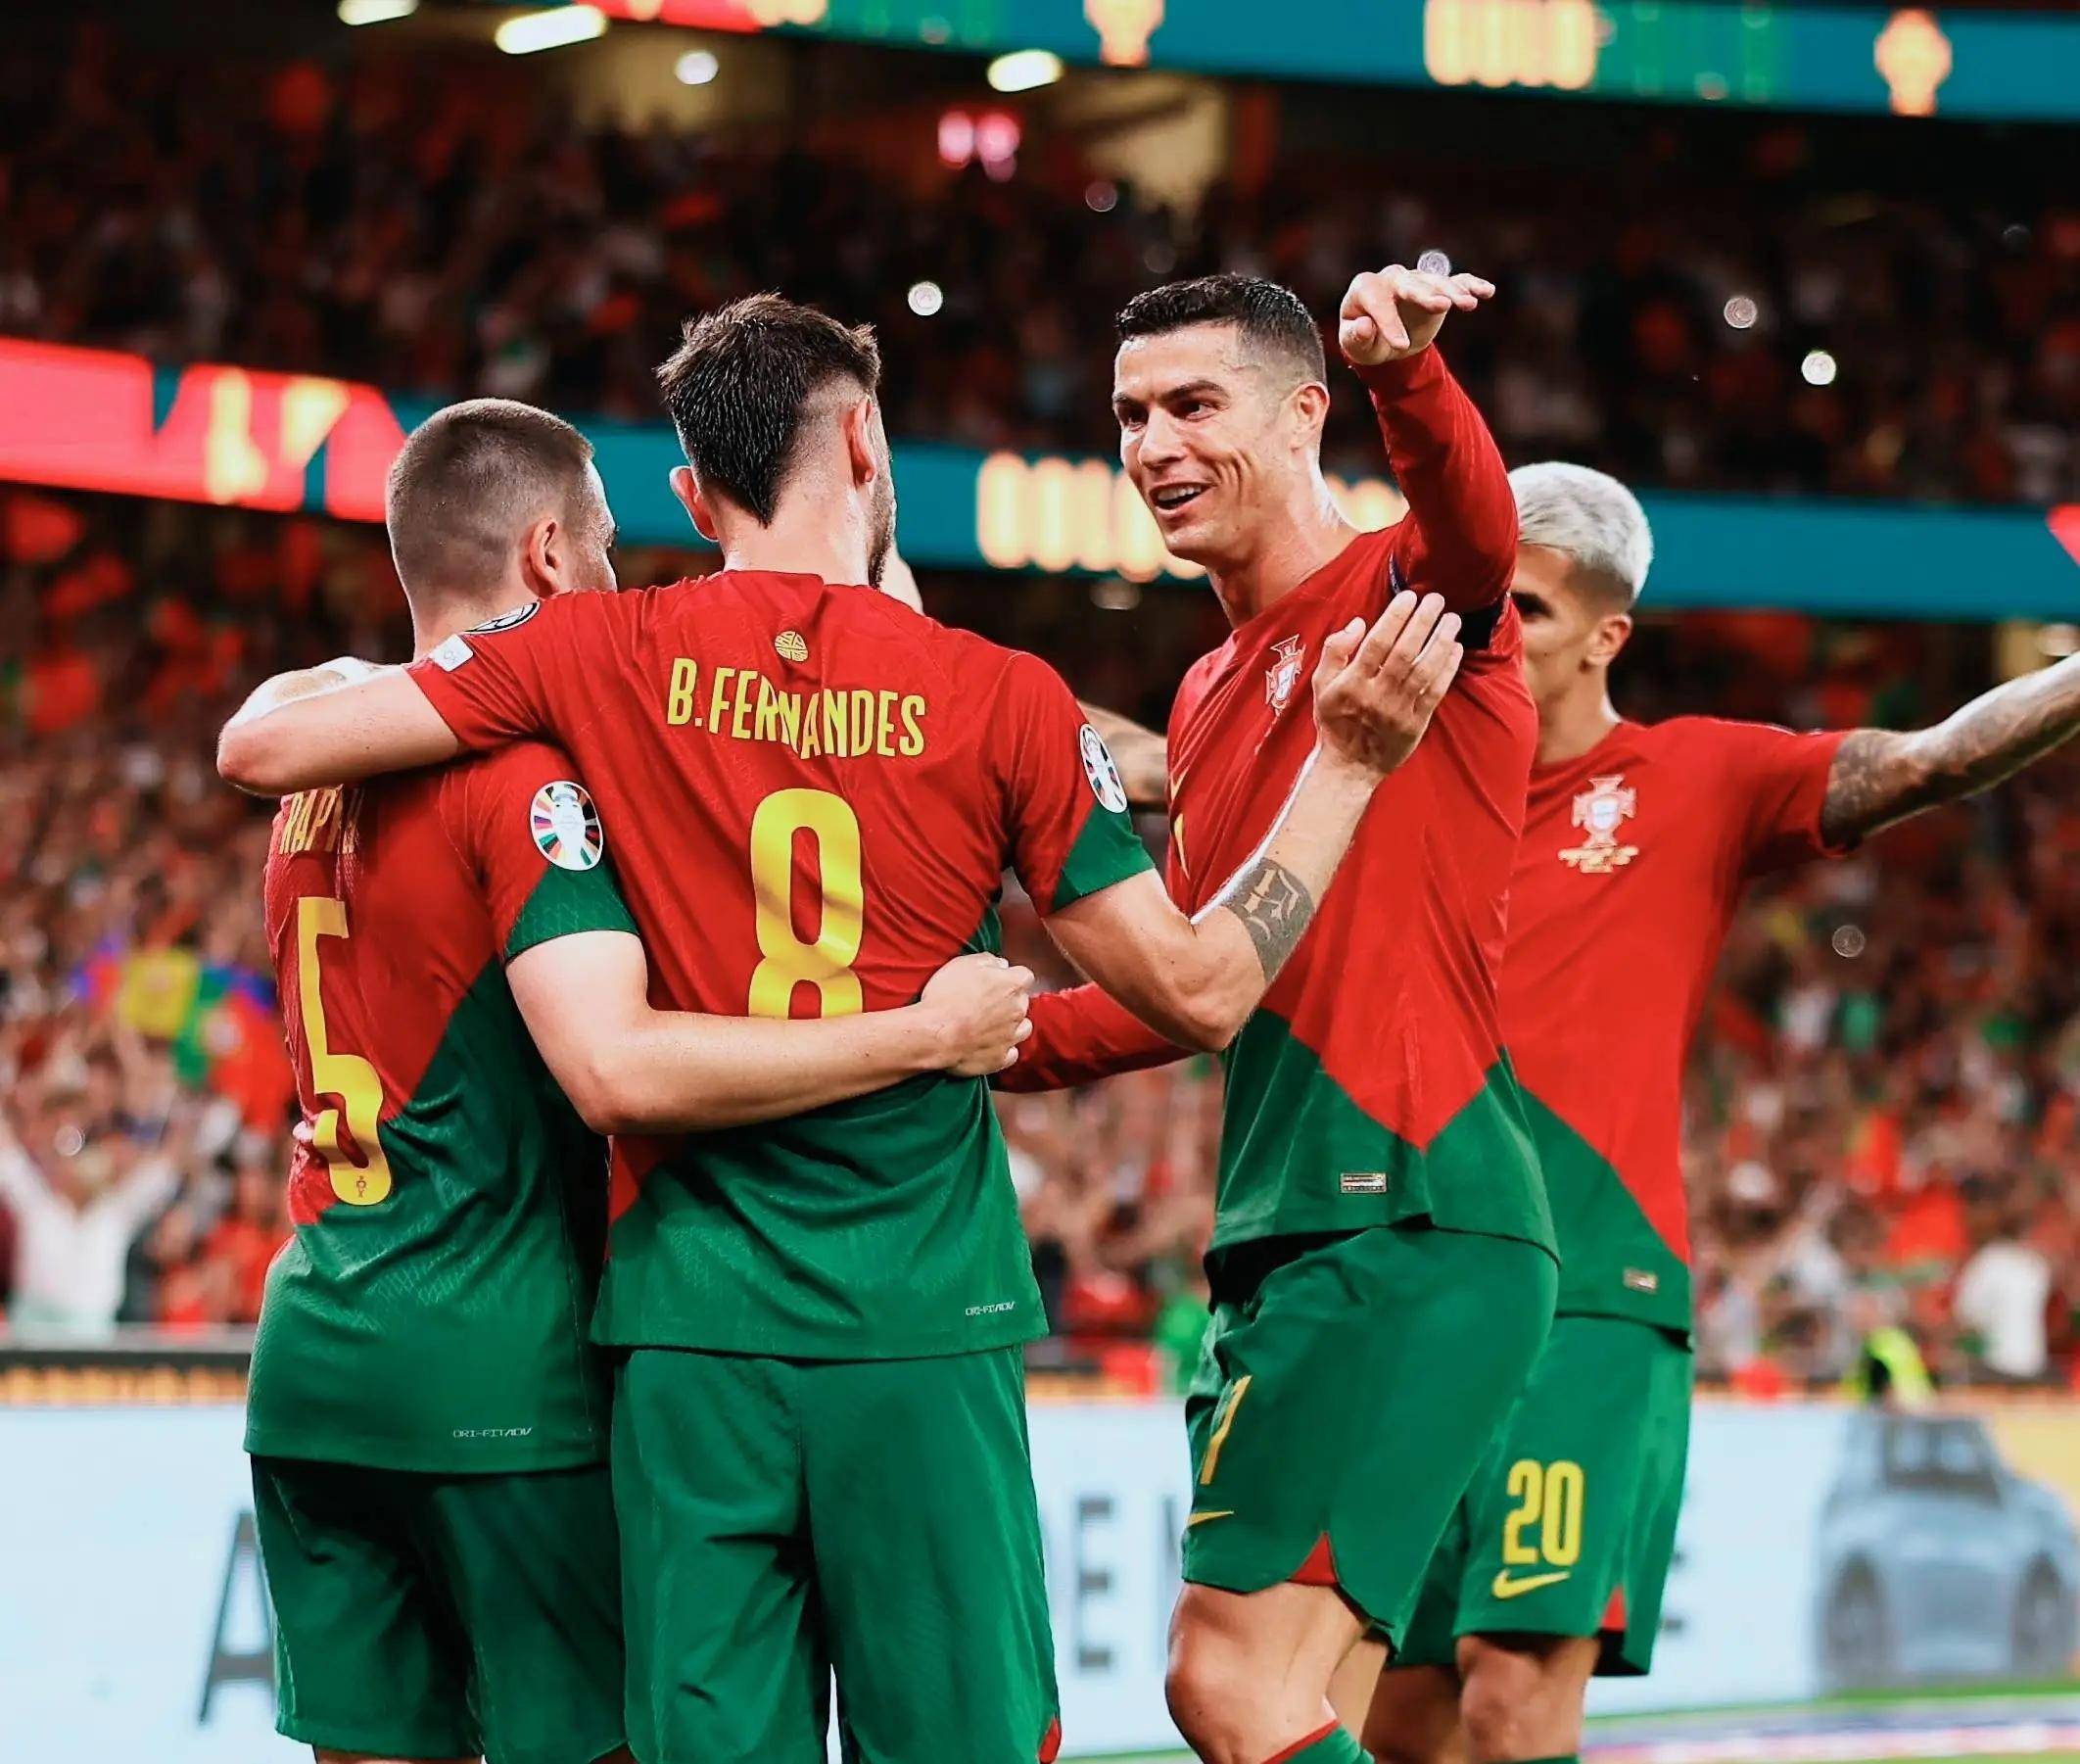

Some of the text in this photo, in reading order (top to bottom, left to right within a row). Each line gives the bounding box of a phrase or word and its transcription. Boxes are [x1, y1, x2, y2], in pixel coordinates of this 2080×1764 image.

[667, 657, 926, 760] B.FERNANDES
[748, 787, 865, 1020] 8
[298, 896, 392, 1206] 5
[1503, 1458, 1584, 1567] 20
